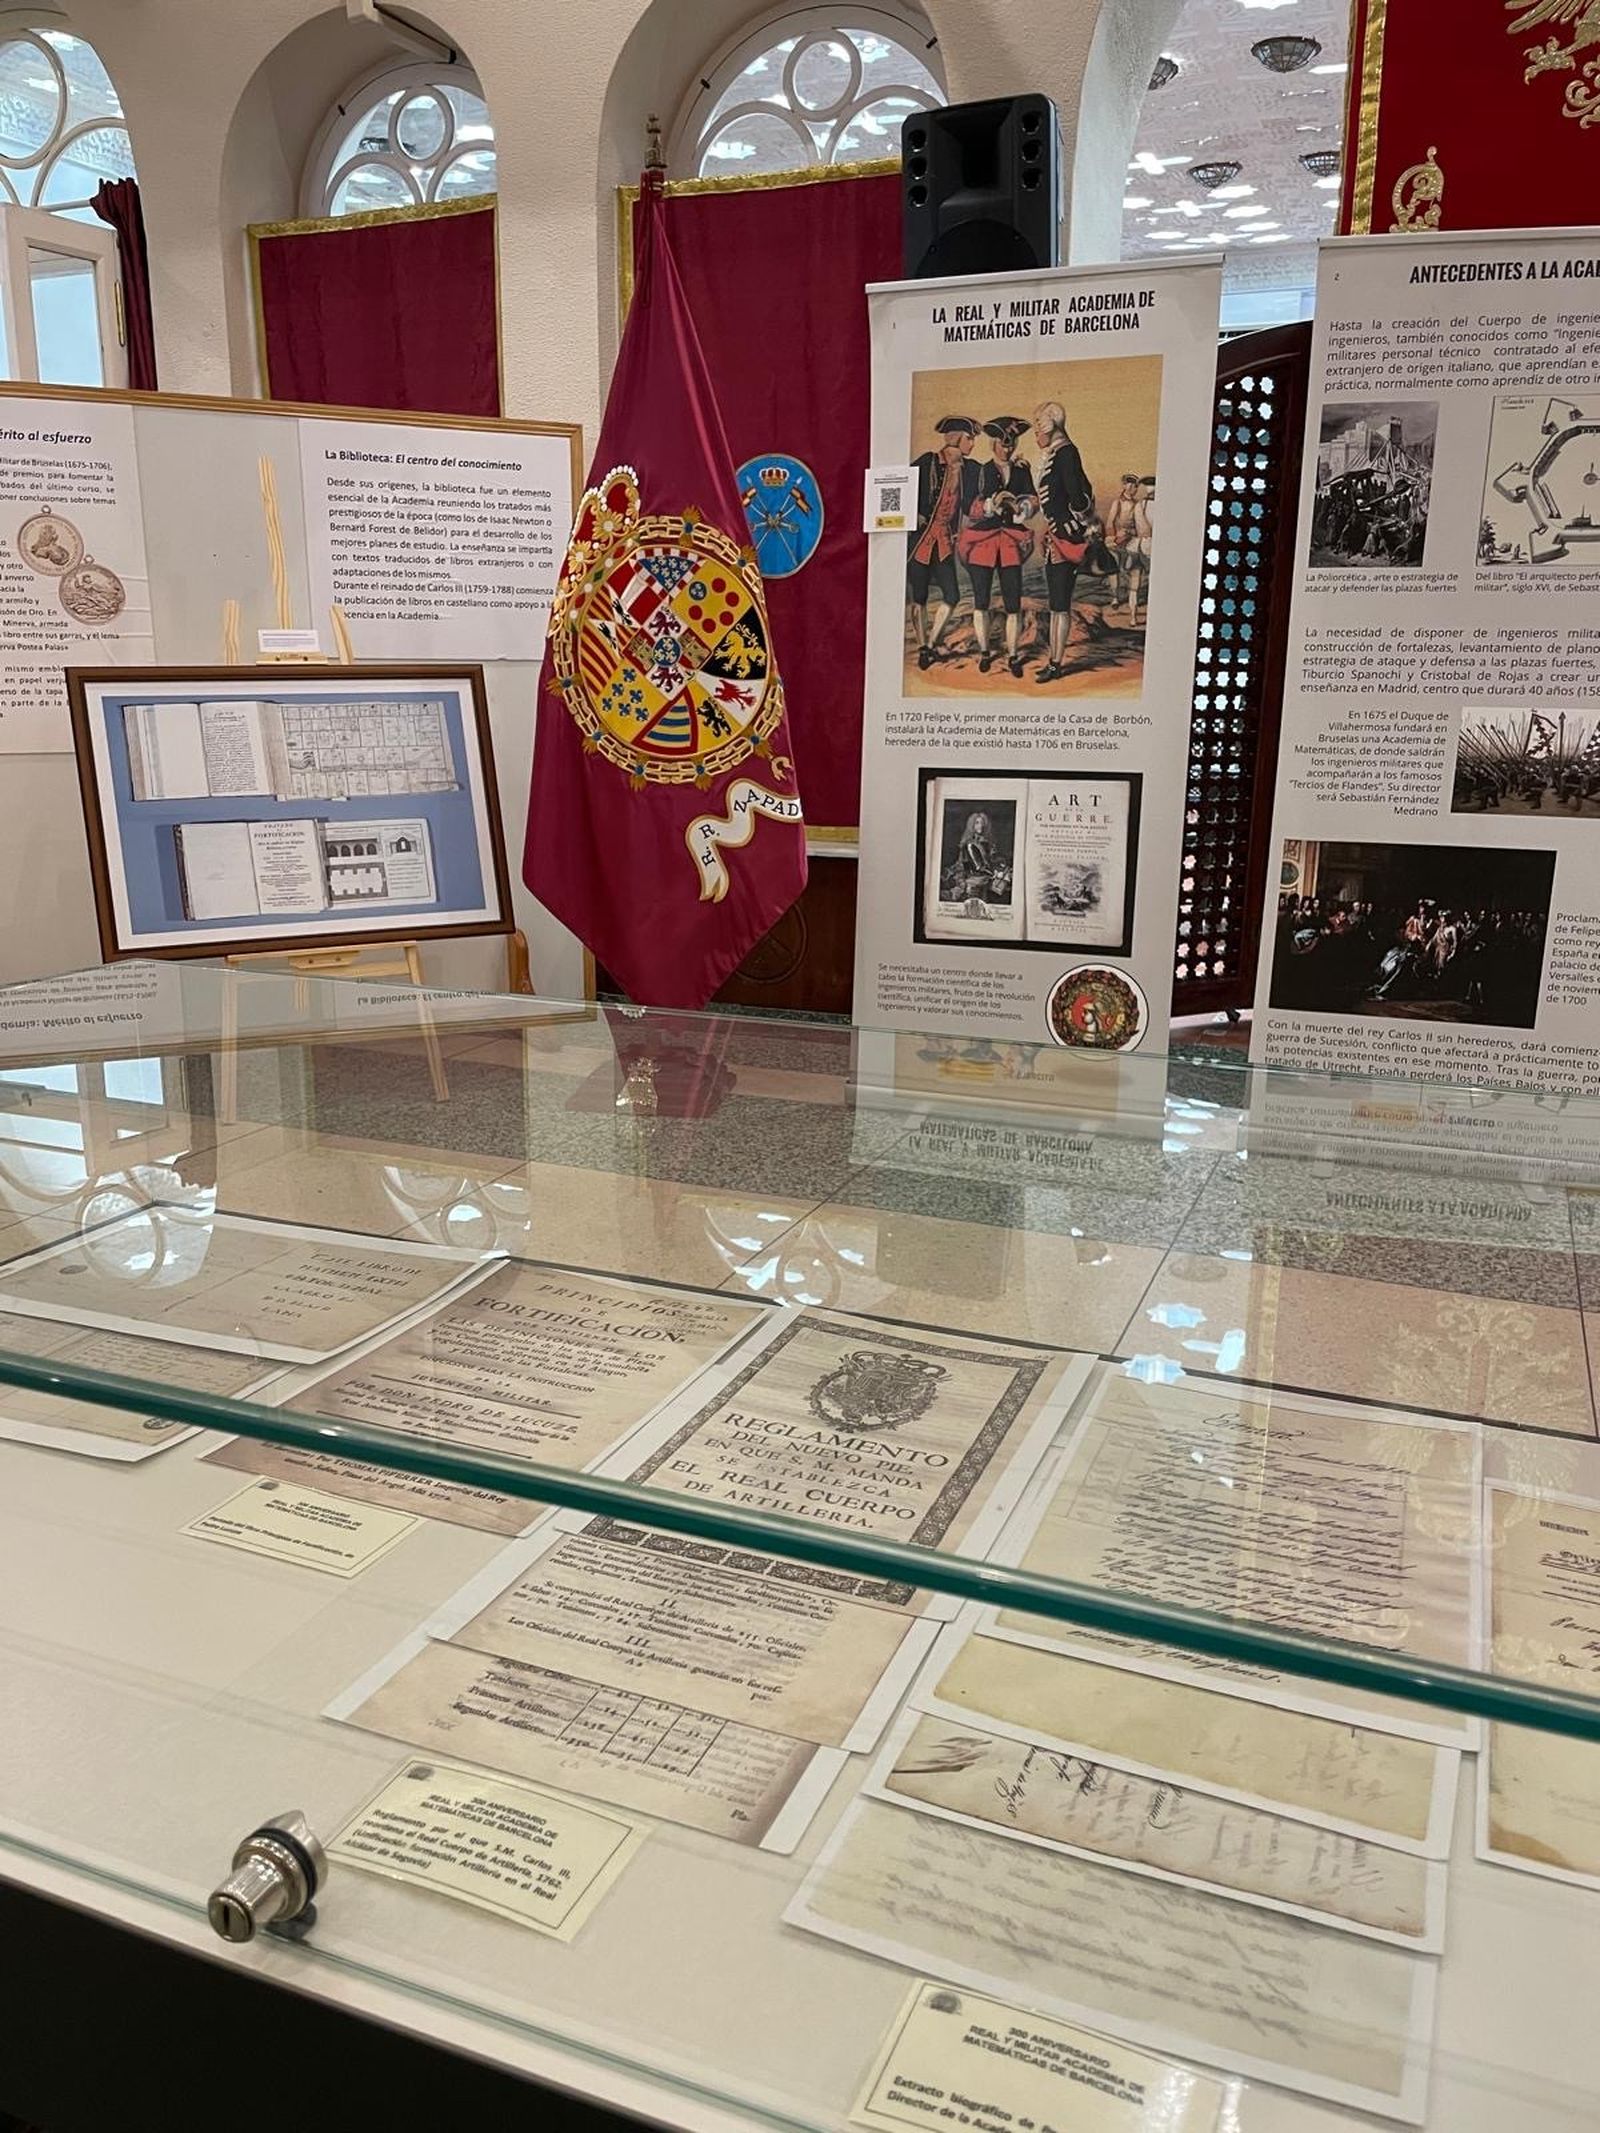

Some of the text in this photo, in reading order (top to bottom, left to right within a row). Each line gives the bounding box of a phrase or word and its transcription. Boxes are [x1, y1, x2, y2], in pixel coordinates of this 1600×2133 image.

[1409, 261, 1523, 284] ANTECEDENTES
[1525, 261, 1537, 280] A
[1540, 260, 1559, 279] LA
[932, 290, 1155, 324] LA REAL Y MILITAR ACADEMIA DE
[943, 312, 1140, 342] MATEMÁTICAS DE BARCELONA
[1329, 320, 1362, 332] Hasta
[1371, 319, 1382, 330] la
[1391, 316, 1440, 329] creación
[1449, 316, 1469, 328] del
[1477, 315, 1522, 328] Cuerpo
[1531, 313, 1547, 325] de
[1328, 334, 1390, 349] ingenieros,
[1396, 331, 1444, 344] también
[1449, 329, 1509, 343] conocidos
[1514, 330, 1548, 341] como
[1327, 349, 1376, 362] militares
[1381, 347, 1433, 362] personal
[1438, 346, 1481, 358] técnico
[1493, 343, 1560, 356] contratado
[1564, 342, 1577, 354] al
[1325, 364, 1384, 378] extranjero
[1387, 363, 1403, 375] de
[1406, 362, 1444, 377] origen
[1447, 360, 1494, 373] italiano,
[1498, 362, 1522, 373] que
[1525, 357, 1587, 372] aprendían
[1324, 379, 1372, 394] práctica,
[1374, 377, 1454, 390] normalmente
[1456, 377, 1490, 388] como
[1491, 373, 1545, 389] aprendiz
[1546, 373, 1562, 385] de
[1565, 374, 1591, 385] otro
[27, 430, 39, 441] al
[42, 431, 92, 445] esfuerzo
[324, 449, 522, 471] La Biblioteca: El centro del conocimiento
[326, 476, 552, 498] Desde sus orígenes, la biblioteca fue un elemento
[327, 493, 552, 512] esencial de la Academia reuniendo los tratados más
[1305, 627, 1318, 638] La
[1326, 626, 1382, 638] necesidad
[1390, 627, 1405, 638] de
[1413, 627, 1464, 641] disponer
[1472, 628, 1488, 638] de
[1496, 628, 1558, 642] ingenieros
[885, 711, 1153, 726] En 1720 Felipe V, primer monarca de la Casa de Borbón,
[884, 724, 1130, 739] instalará la Academia de Matemáticas en Barcelona,
[884, 736, 1120, 751] heredera de la que existió hasta 1706 en Bruselas.
[733, 789, 799, 816] ZAPAD
[1048, 794, 1102, 807] ART
[345, 1380, 376, 1390] POR
[379, 1387, 416, 1399] DON
[419, 1396, 474, 1412] PEDRO
[480, 1408, 506, 1418] DE
[722, 1412, 949, 1468] REGLAMENTO
[704, 1438, 925, 1490] EN QUE S. M. MANDA
[785, 1441, 862, 1464] NUEVO
[715, 1455, 891, 1498] SE ESTABLEZCA
[669, 1460, 916, 1520] EL REAL CUERPO
[684, 1479, 875, 1528] DE ARTILLERIA.
[969, 2025, 1145, 2094] REAL Y MILITAR ACADEMIA DE
[1008, 2027, 1110, 2069] 300 ANIVERSARIO
[1049, 2064, 1068, 2077] DE
[1069, 2070, 1144, 2105] BARCELONA
[894, 2075, 1035, 2129] Extracto biográfico de
